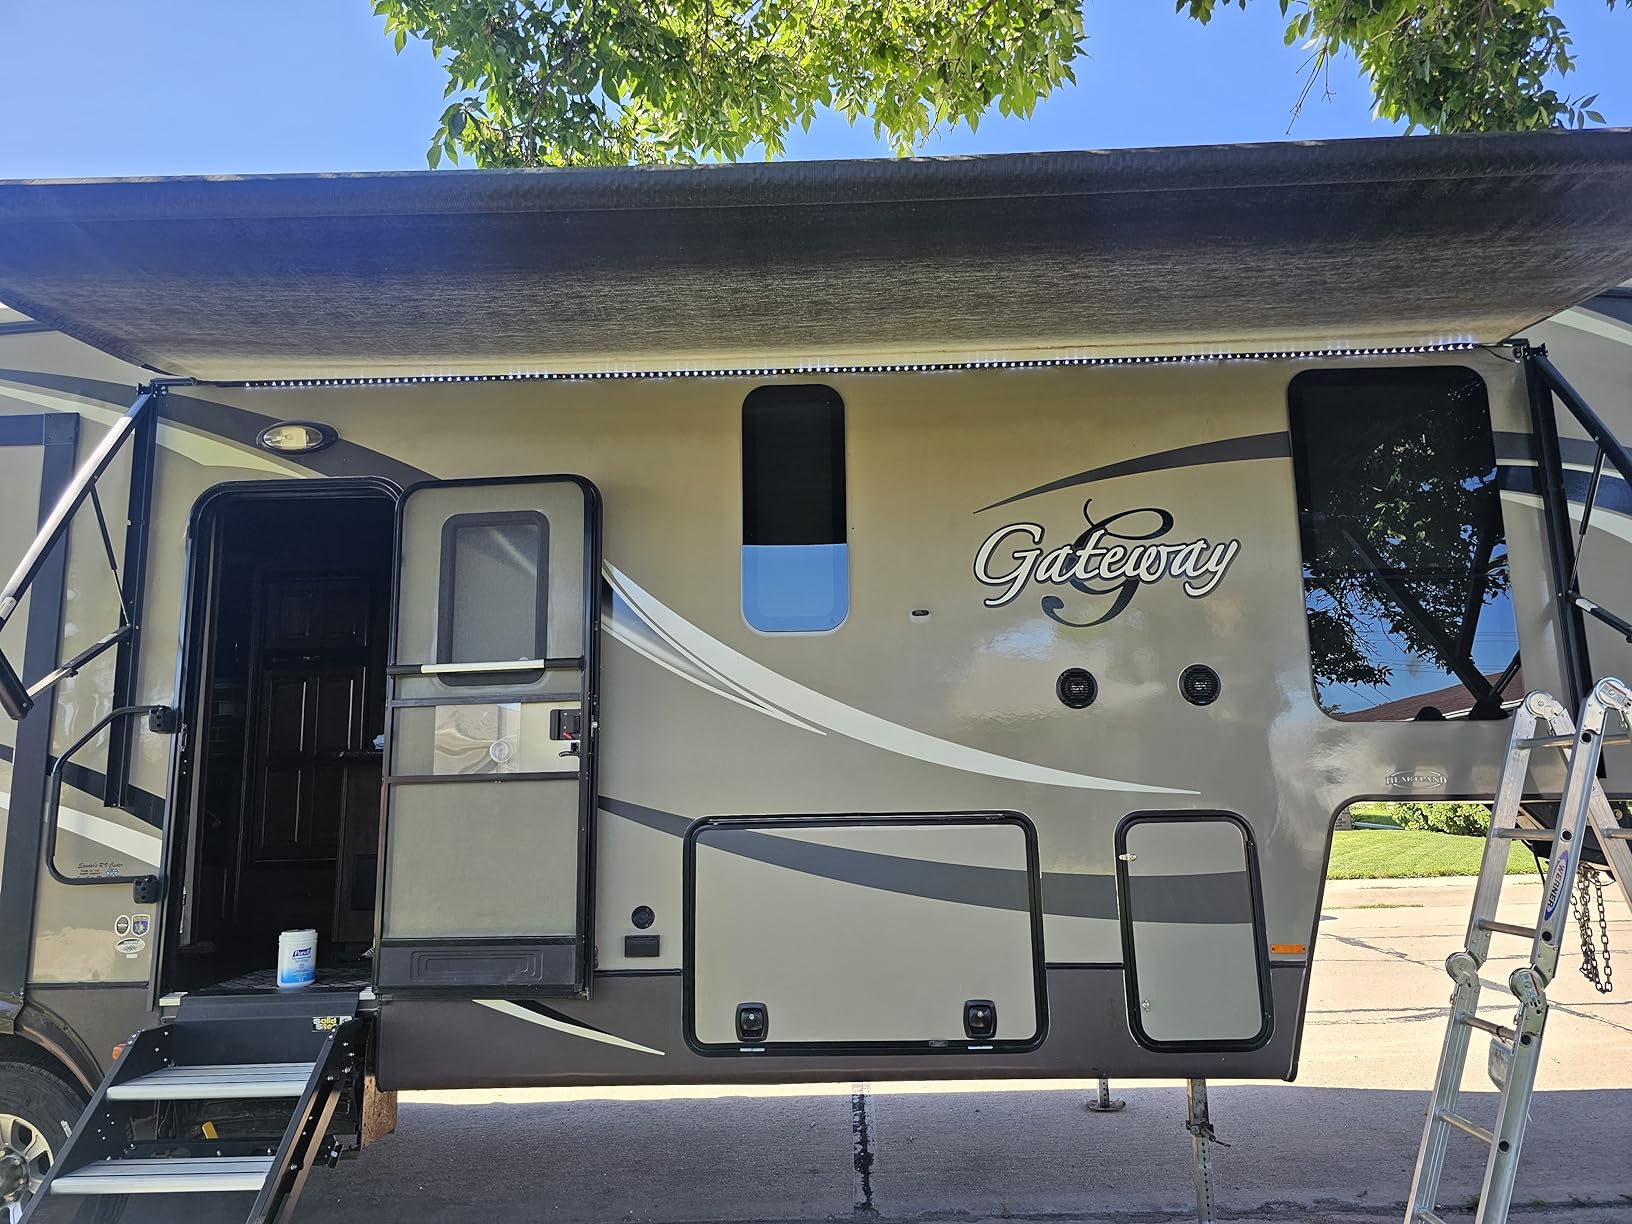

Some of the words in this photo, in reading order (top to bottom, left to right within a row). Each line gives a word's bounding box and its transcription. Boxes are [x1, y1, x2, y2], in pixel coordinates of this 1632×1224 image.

[973, 522, 1242, 608] Gateway
[1384, 775, 1448, 786] HEARTLAND
[1547, 864, 1565, 909] WERNER
